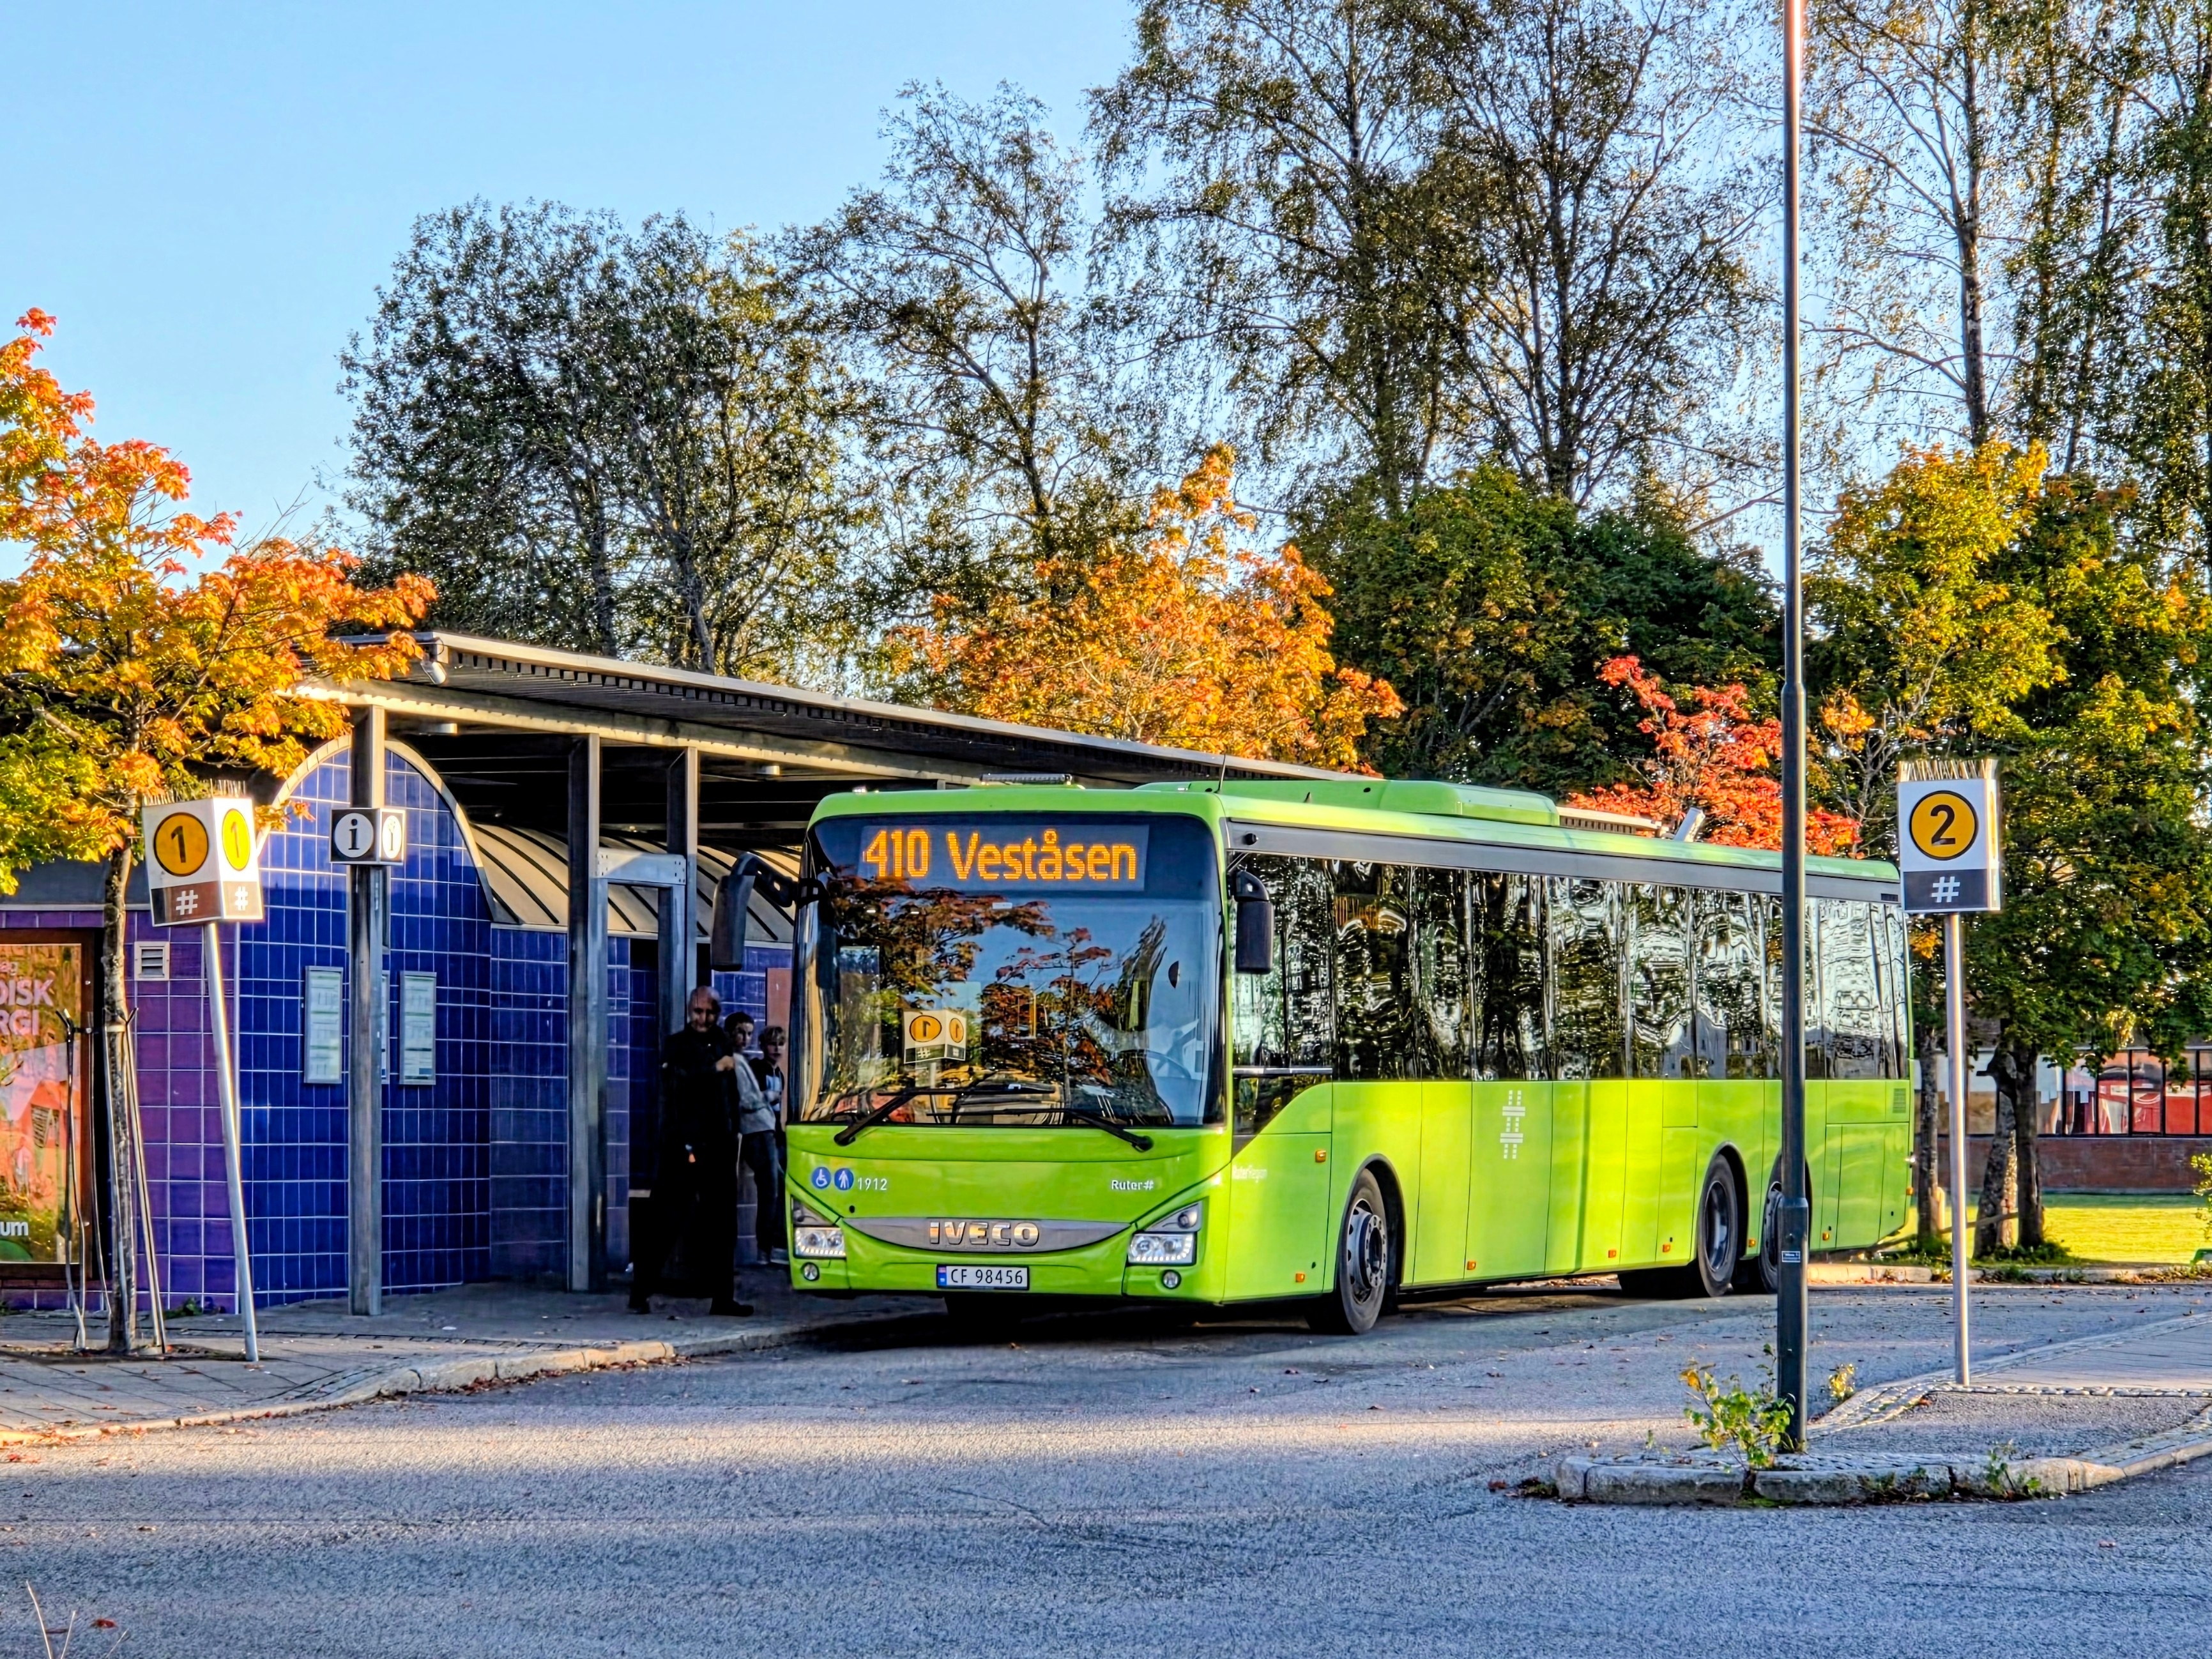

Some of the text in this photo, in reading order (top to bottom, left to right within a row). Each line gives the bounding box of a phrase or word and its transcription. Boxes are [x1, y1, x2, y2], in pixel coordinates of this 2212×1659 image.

[1930, 804, 1956, 845] 2
[171, 825, 187, 863] 1
[863, 829, 1136, 880] 410 Veståsen
[858, 1177, 888, 1191] 1912
[929, 1221, 1039, 1246] IVECO
[951, 1269, 1023, 1284] CF 98456
